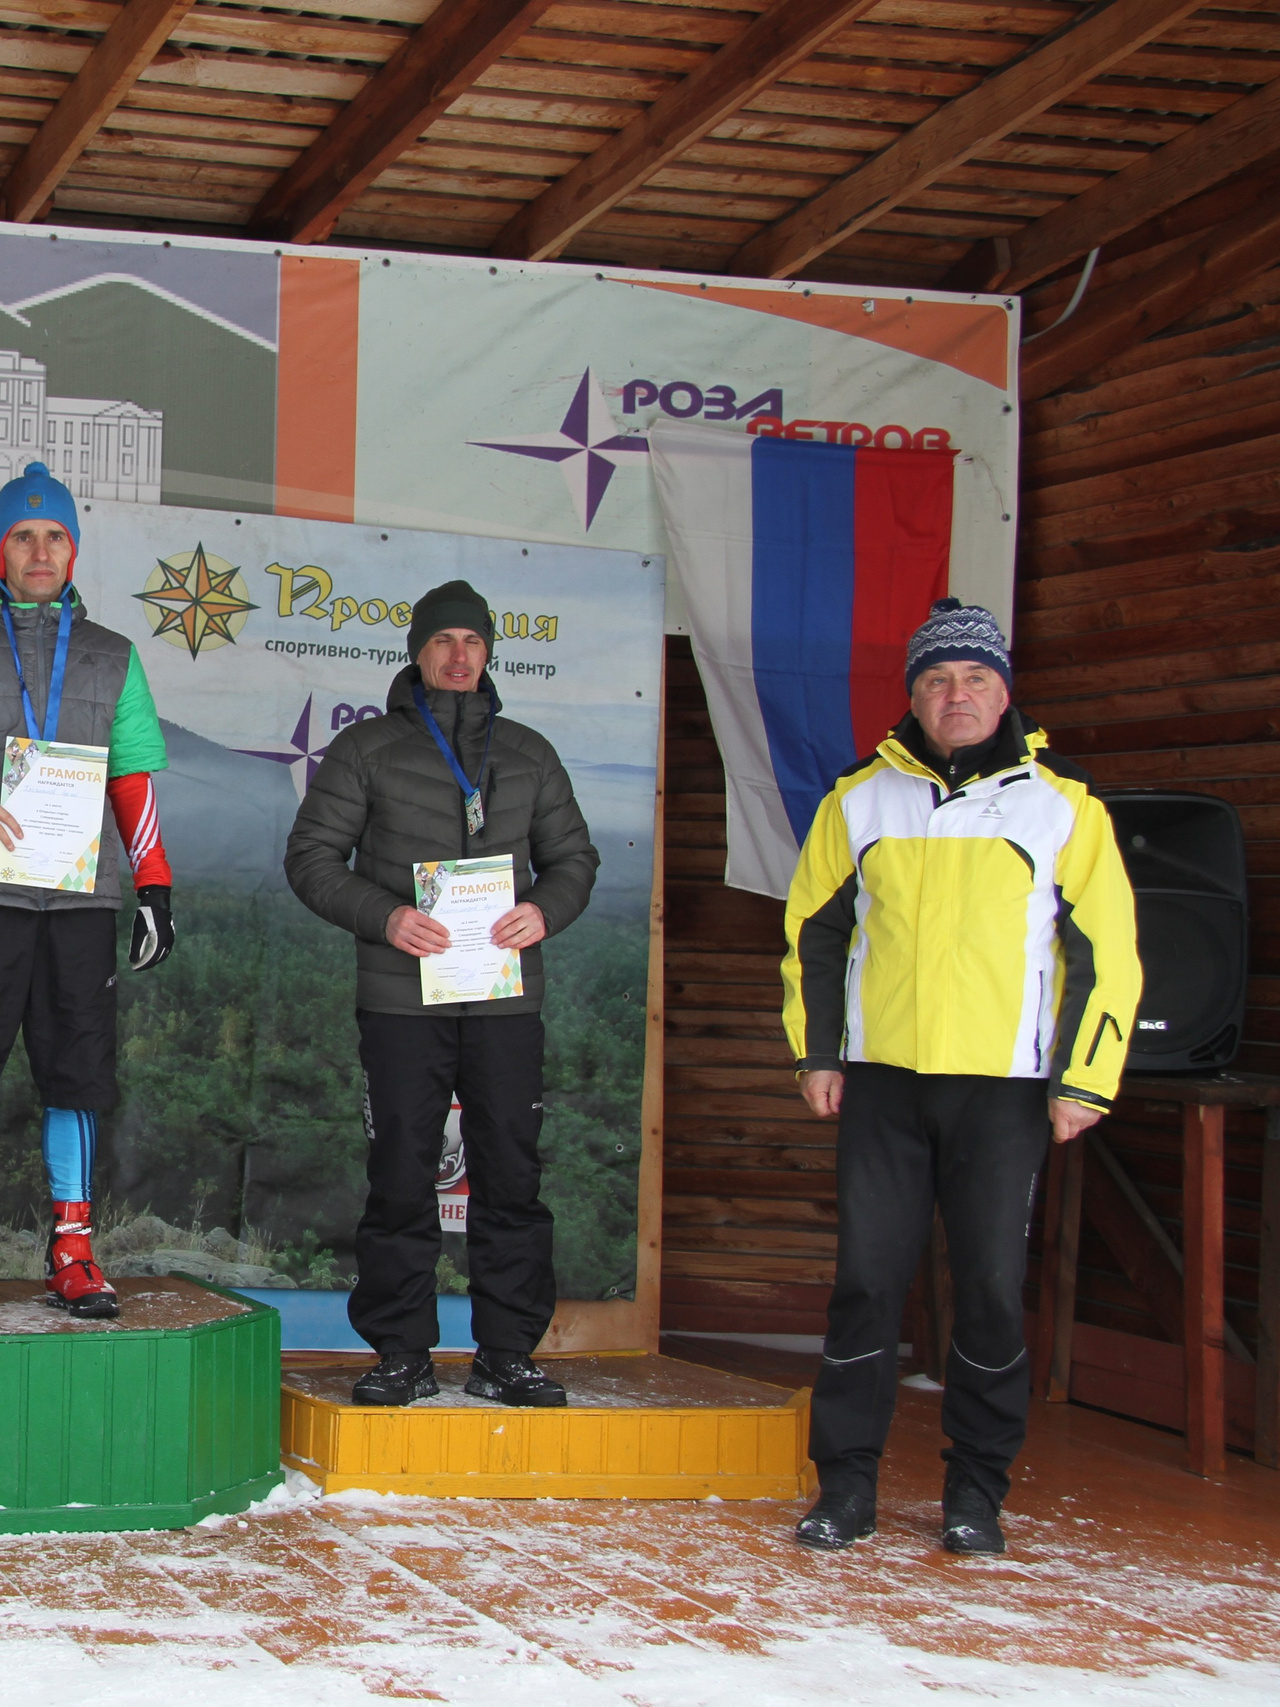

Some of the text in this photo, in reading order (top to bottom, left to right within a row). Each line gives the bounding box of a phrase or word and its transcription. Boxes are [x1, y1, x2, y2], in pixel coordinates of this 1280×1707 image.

[623, 379, 783, 421] РОЗА
[265, 562, 558, 642] Провия
[505, 660, 556, 677] центр
[40, 767, 102, 783] ГРАМОТА
[451, 880, 510, 896] ГРАМОТА
